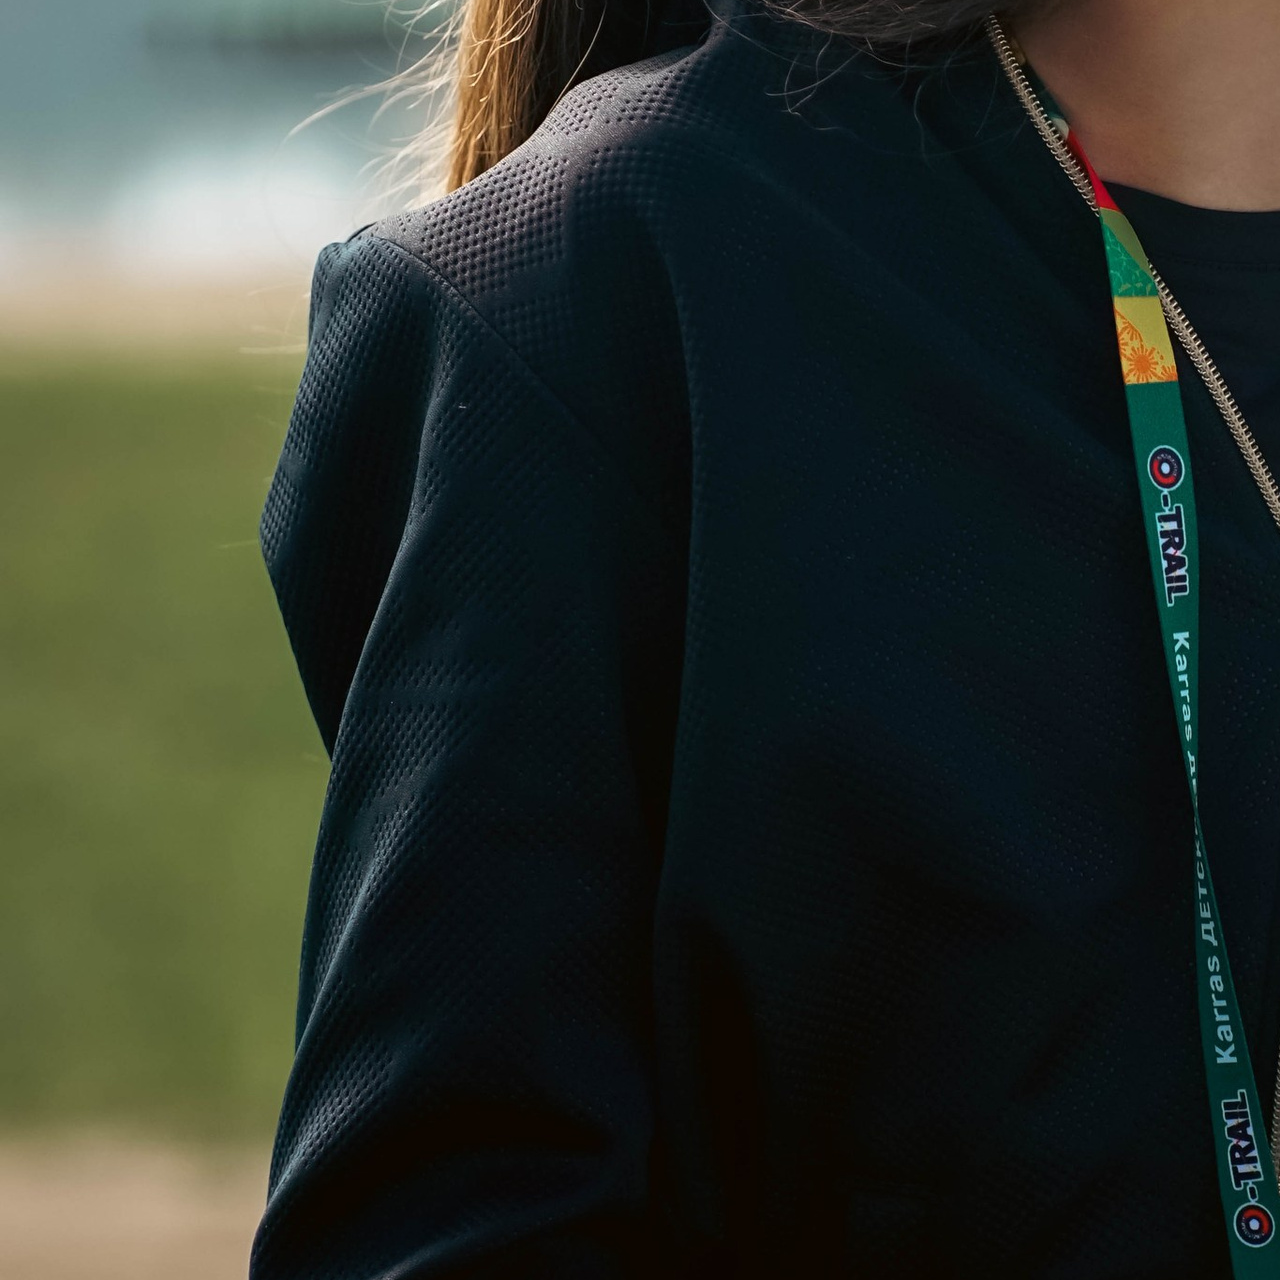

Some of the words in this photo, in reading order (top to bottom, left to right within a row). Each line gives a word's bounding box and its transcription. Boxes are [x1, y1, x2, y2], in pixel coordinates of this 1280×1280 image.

[1147, 444, 1190, 608] O-TRAIL
[1172, 630, 1196, 741] Karras
[1206, 956, 1239, 1064] Karras
[1221, 1088, 1276, 1249] O-TRAIL
